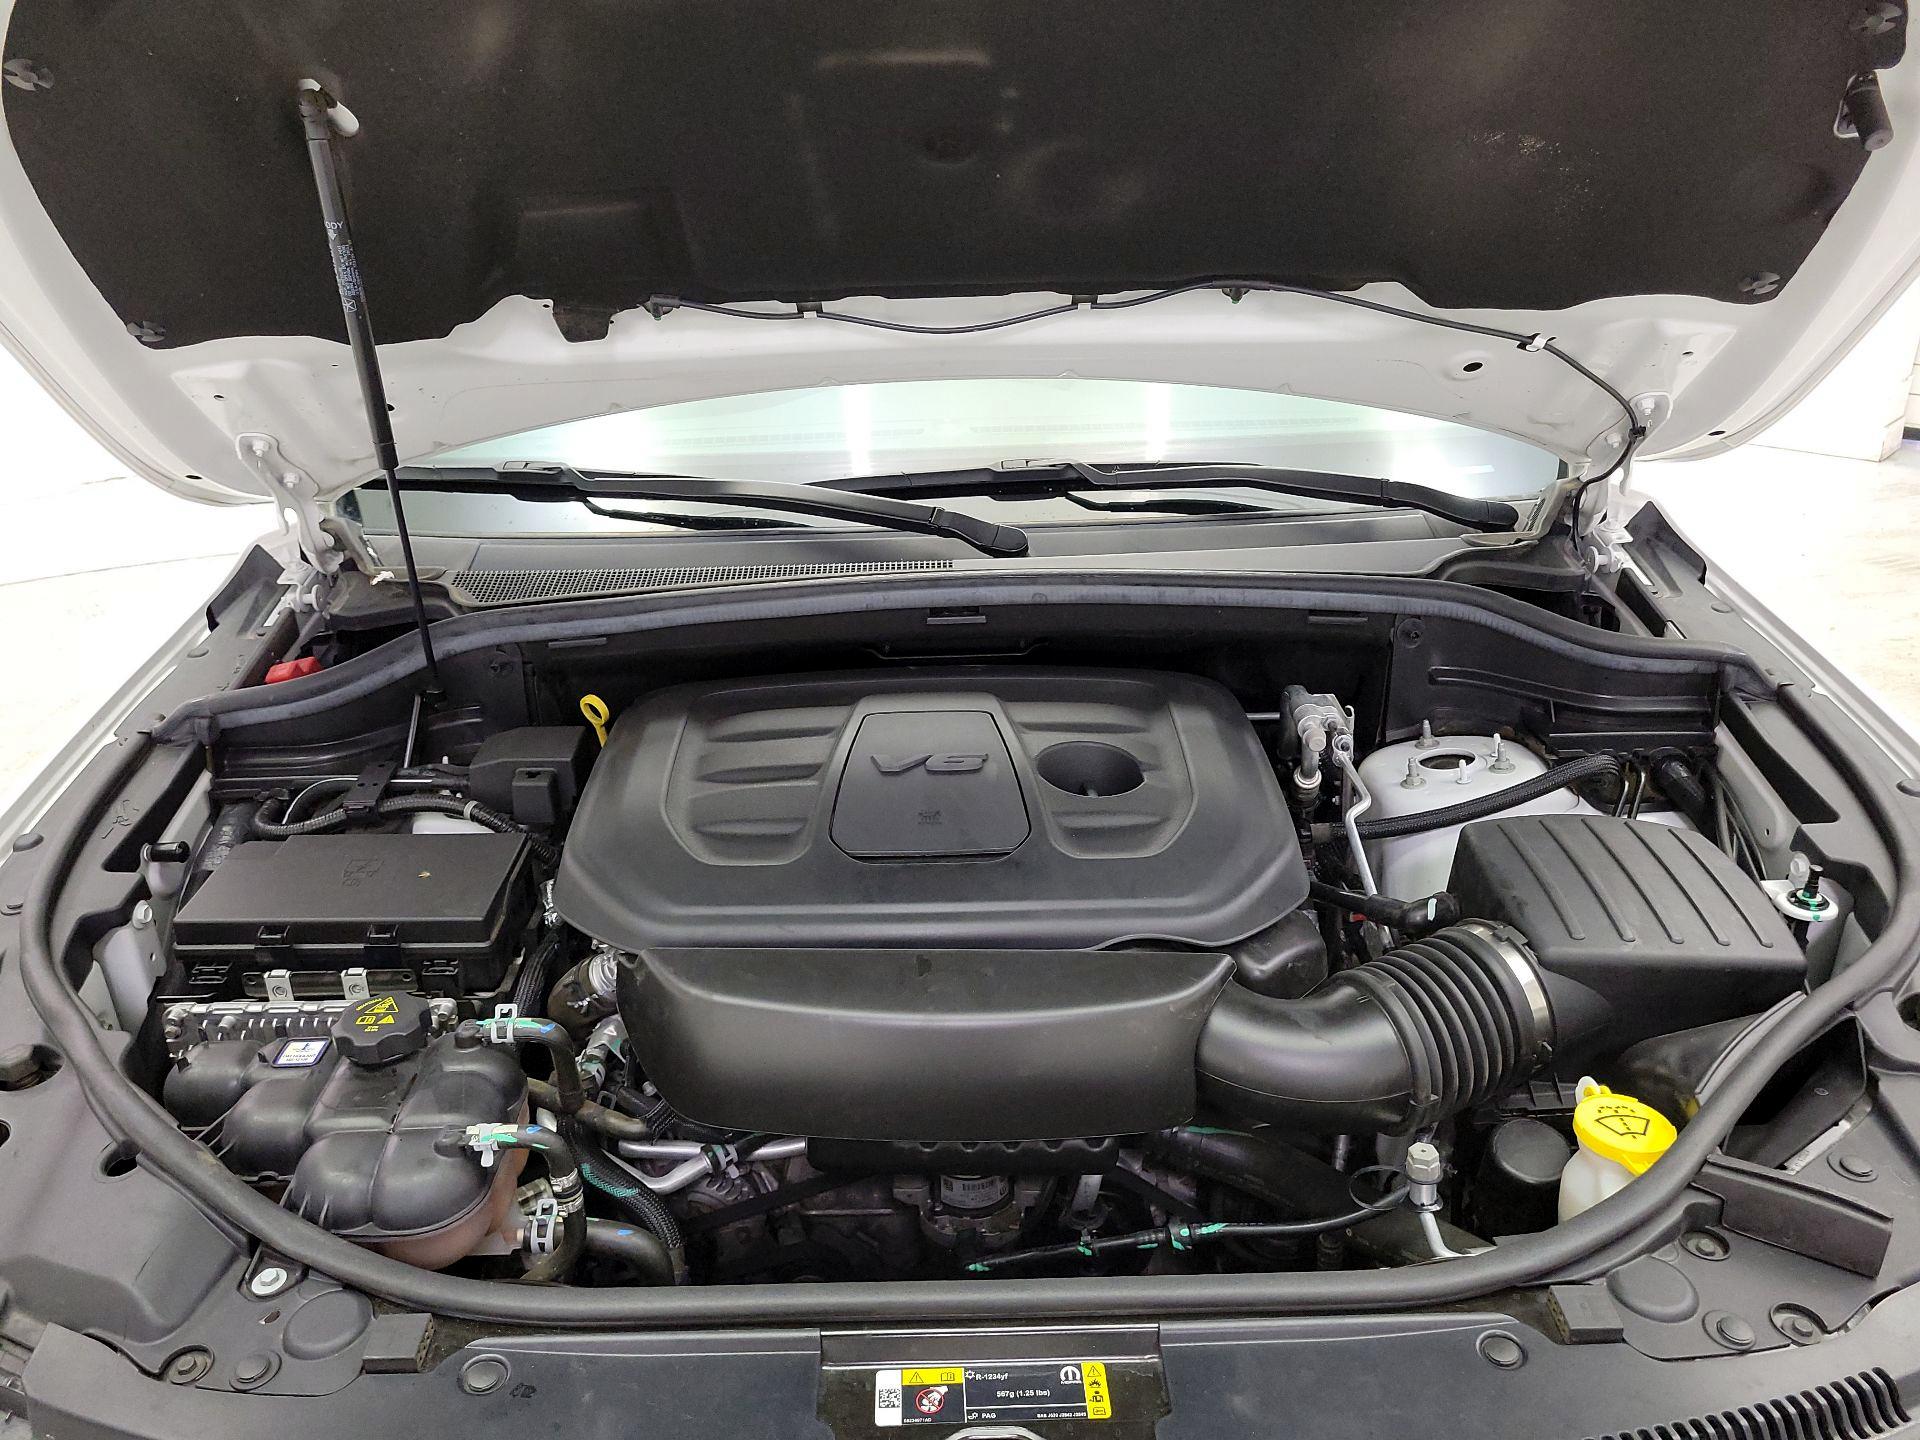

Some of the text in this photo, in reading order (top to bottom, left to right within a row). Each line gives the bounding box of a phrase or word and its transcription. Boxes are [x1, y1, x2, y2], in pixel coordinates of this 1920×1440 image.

[325, 221, 343, 229] ODY
[870, 753, 989, 774] V6
[997, 1389, 1051, 1398] 567g (1.25 lbs)
